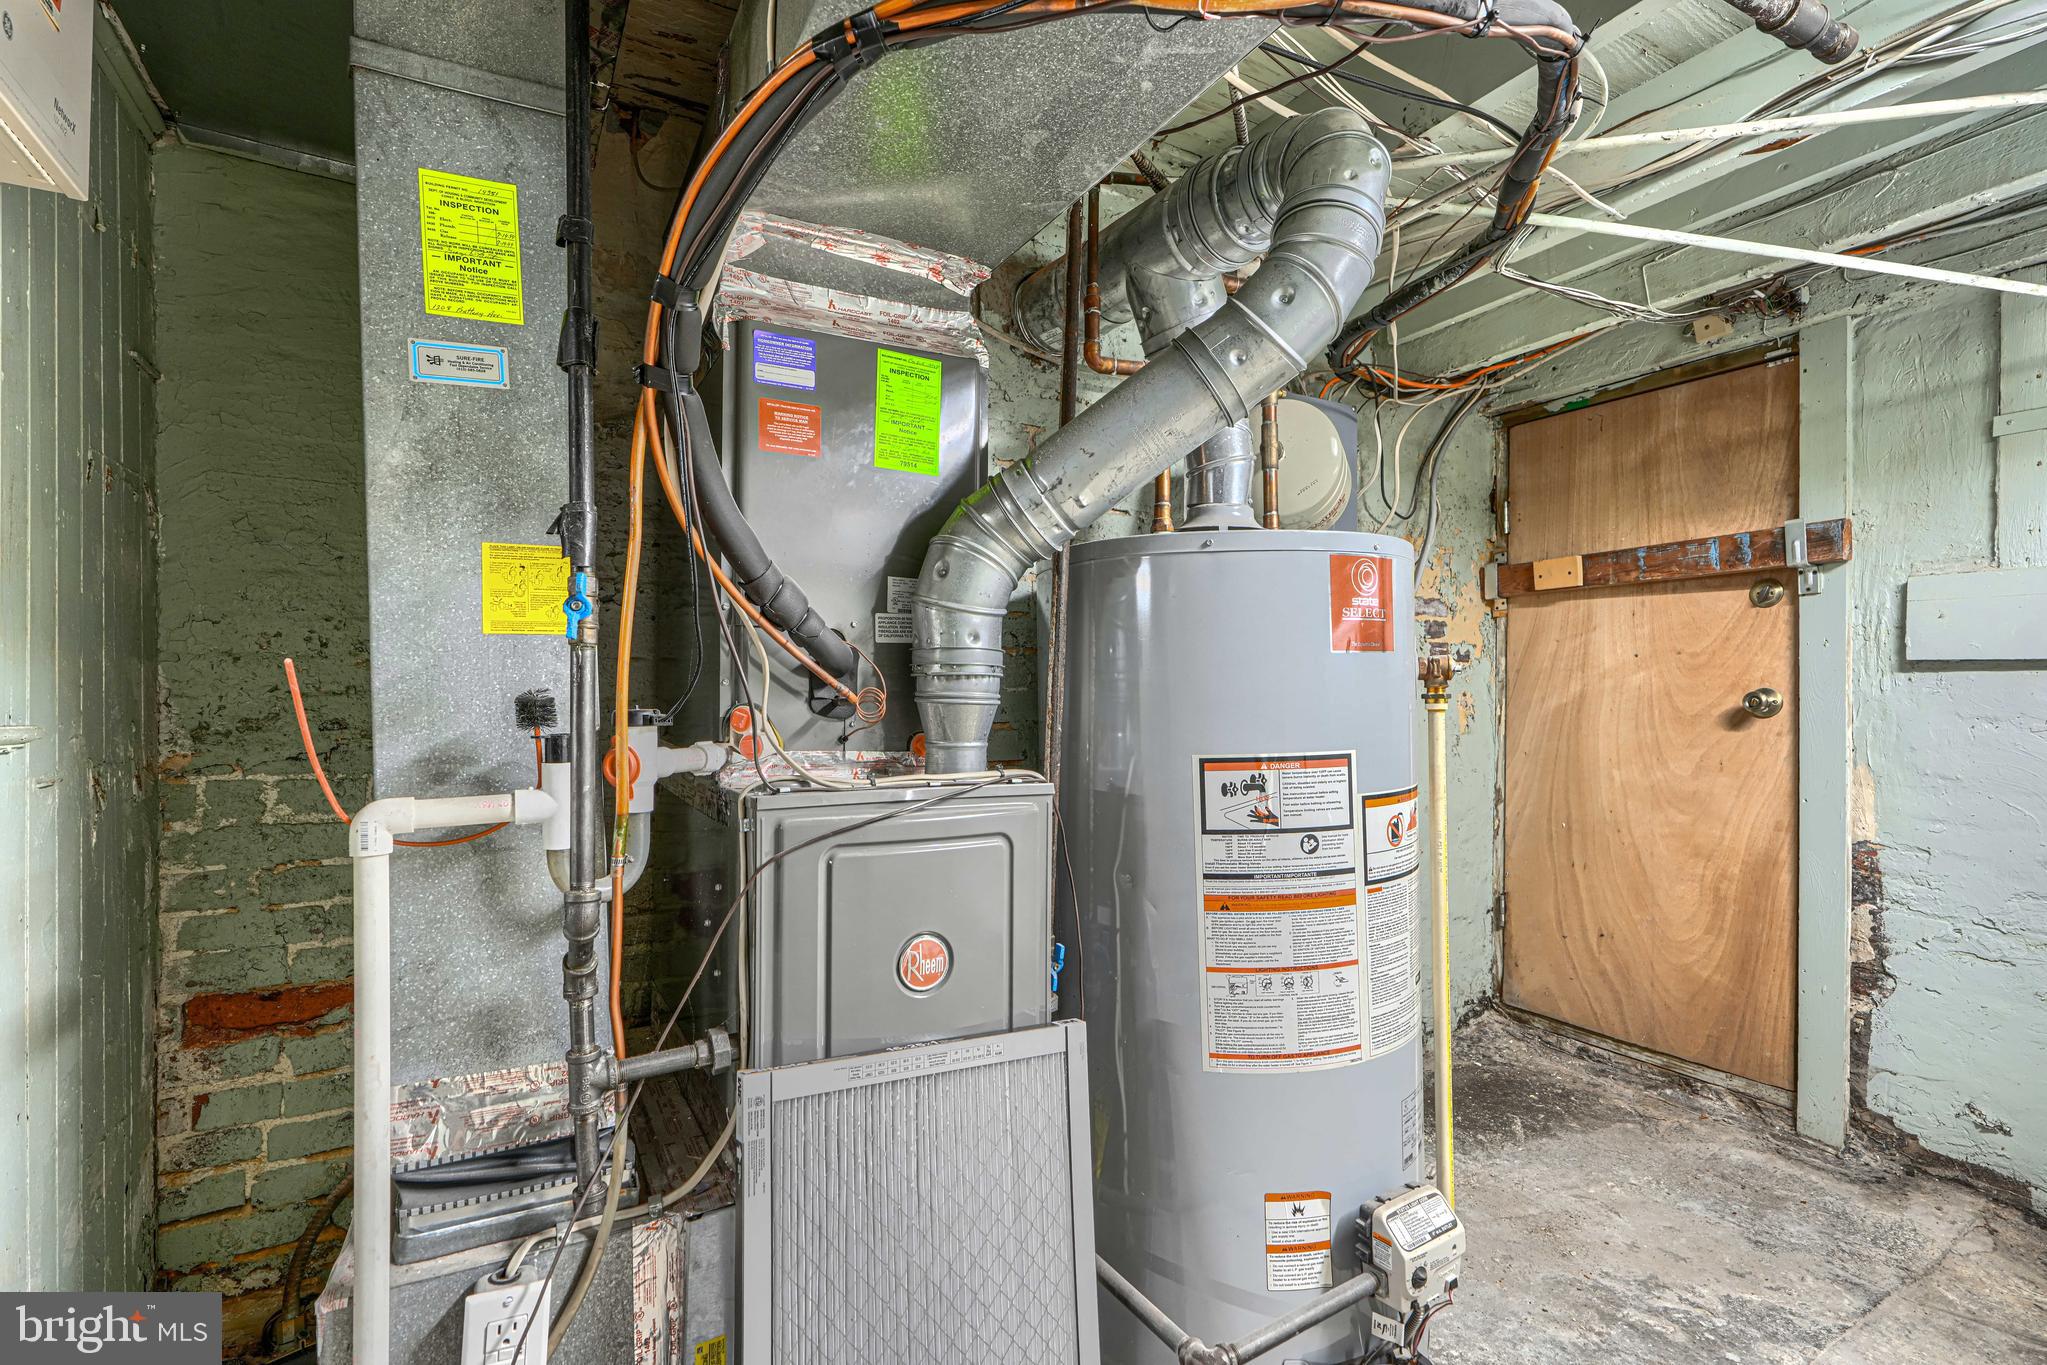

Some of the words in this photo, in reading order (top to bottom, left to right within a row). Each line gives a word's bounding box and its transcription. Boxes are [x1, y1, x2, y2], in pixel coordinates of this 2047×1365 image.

[440, 199, 499, 216] INSPECTION
[444, 254, 502, 268] IMPORTANT
[459, 264, 488, 275] Notice
[889, 367, 930, 381] INSPECTION
[890, 419, 925, 430] IMPORTANT
[1342, 607, 1386, 618] SELECT
[1270, 762, 1300, 770] DANGER
[1253, 871, 1317, 880] IMPORTANT/IMPORTANTE
[1315, 890, 1337, 898] LIGHTING
[907, 943, 944, 982] Rheem
